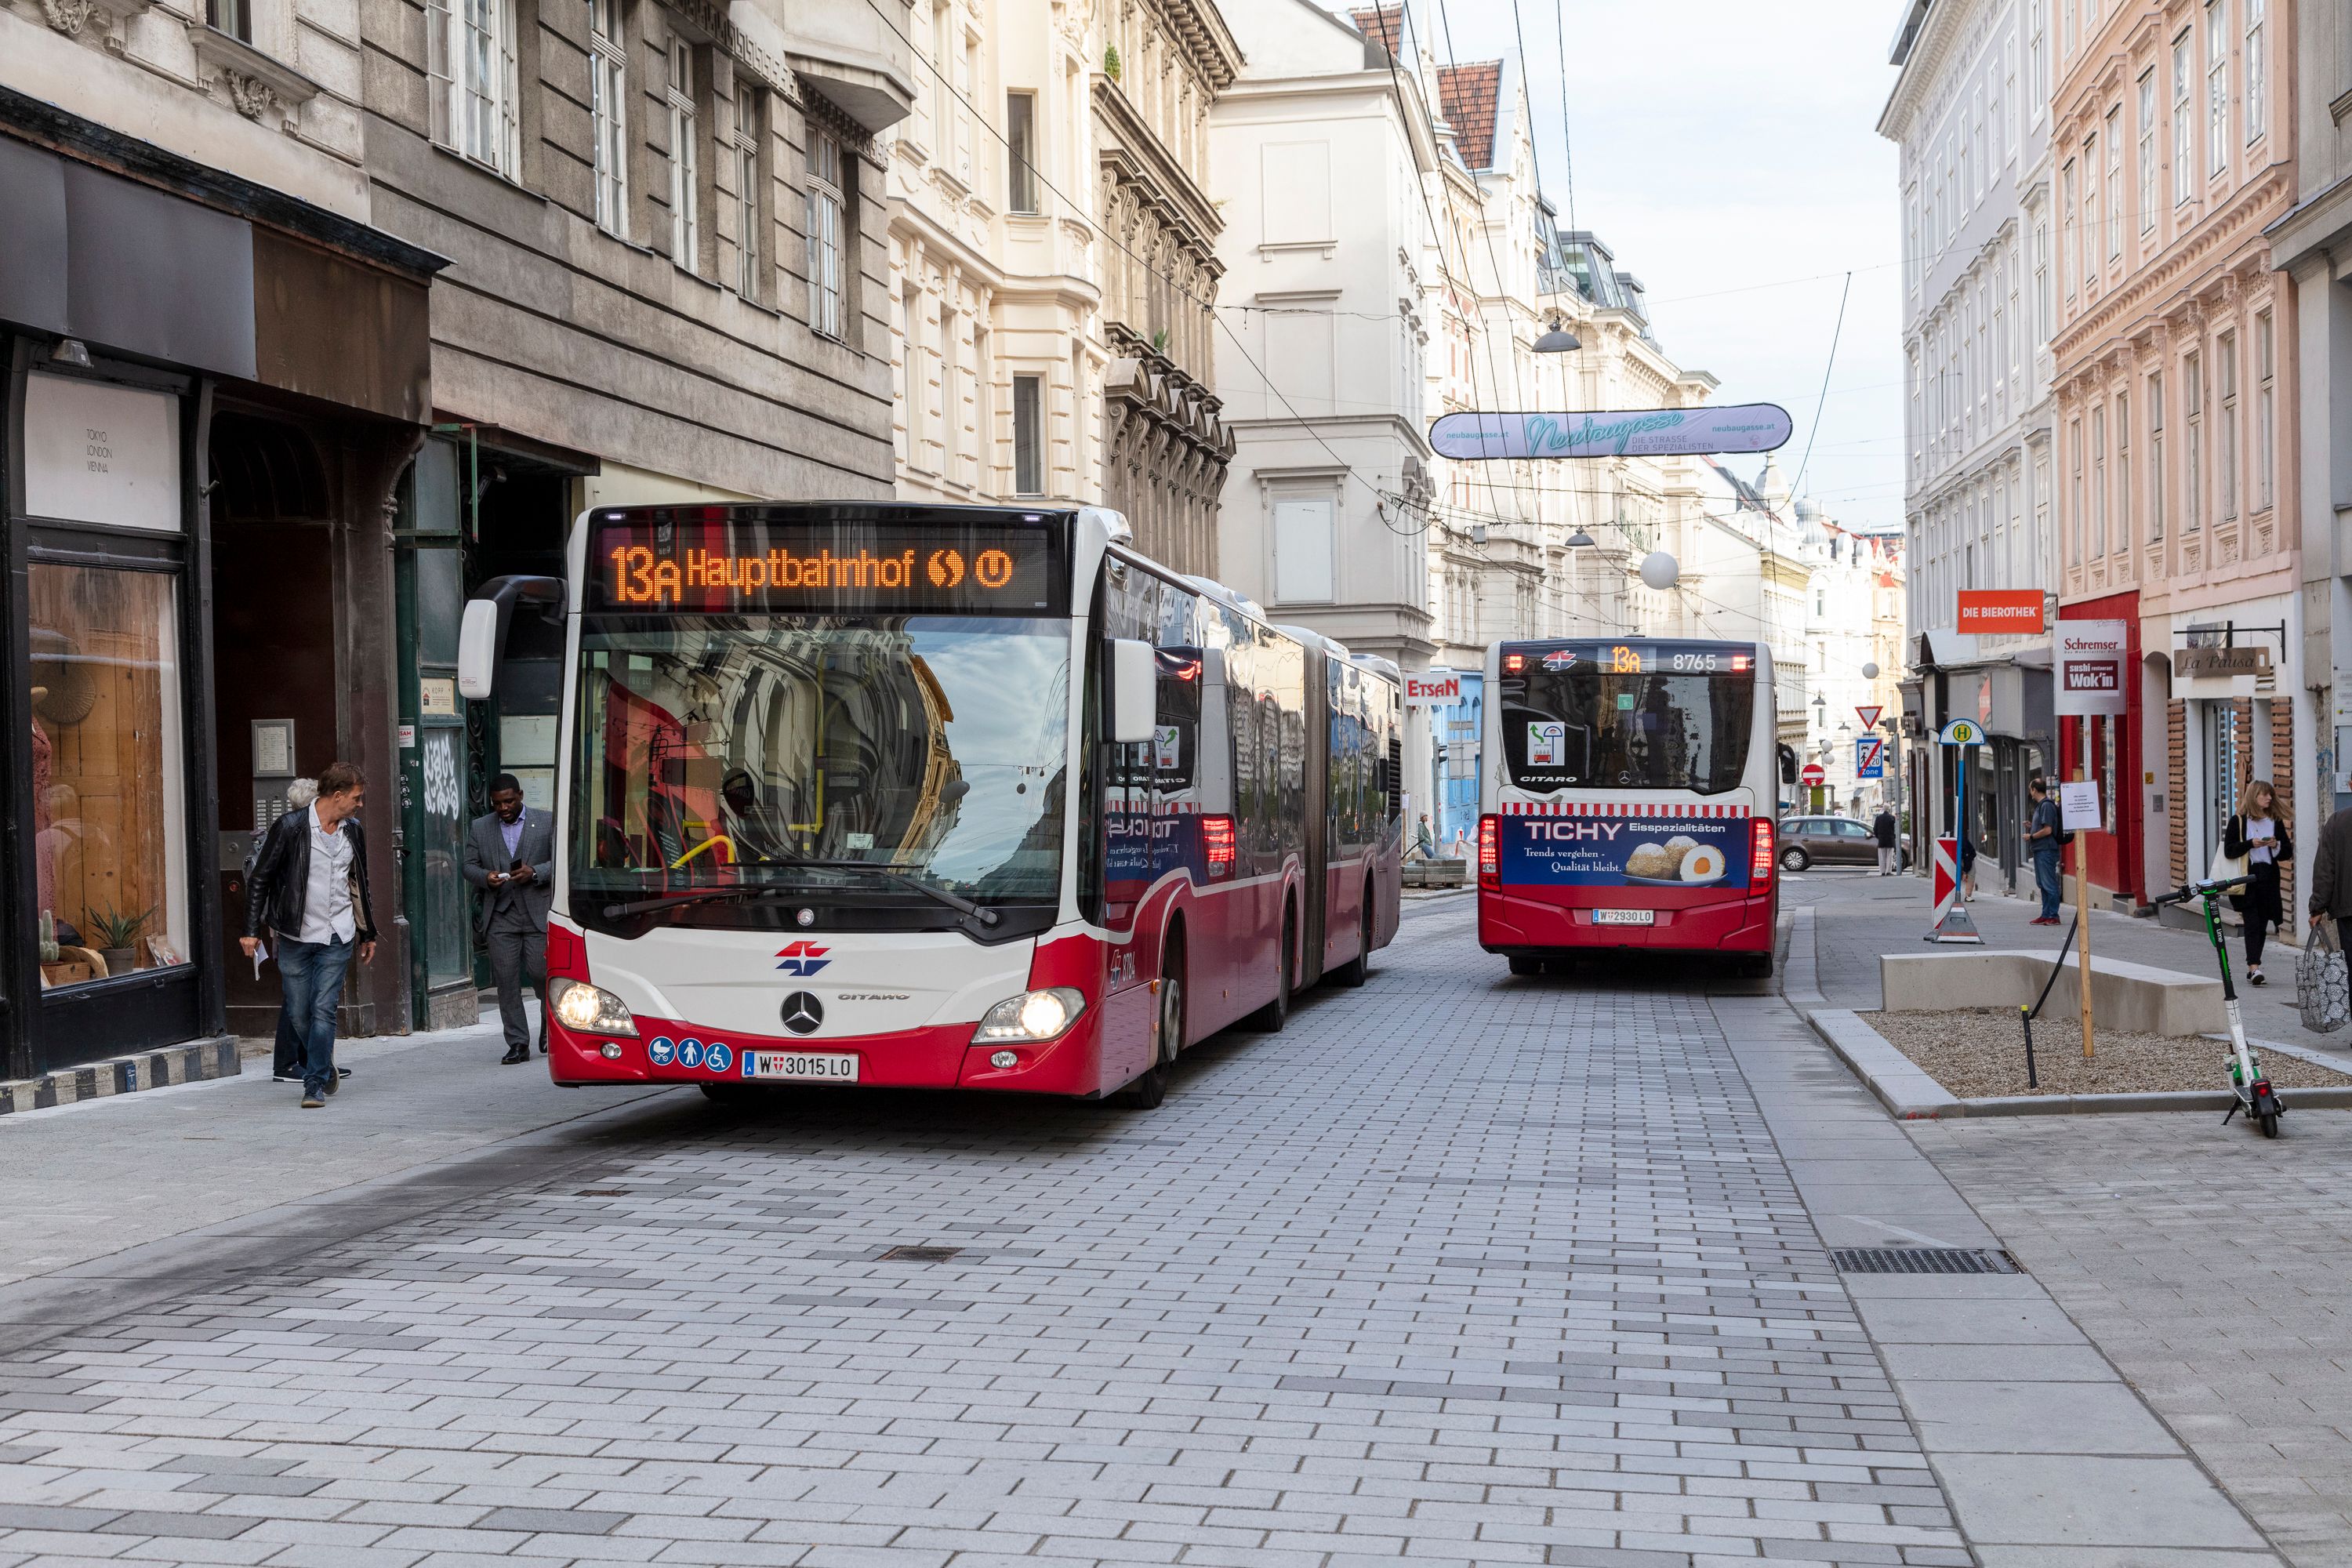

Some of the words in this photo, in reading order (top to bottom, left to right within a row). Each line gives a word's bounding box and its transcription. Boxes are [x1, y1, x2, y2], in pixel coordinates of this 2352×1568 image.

[1526, 411, 1685, 456] Neubaugasse
[1711, 423, 1776, 434] neubaugasse.at
[86, 428, 107, 443] TOKYO
[1446, 430, 1510, 441] neubaugasse.at
[86, 445, 112, 459] LONDON
[1632, 444, 1649, 452] DER
[1652, 442, 1714, 452] SPEZIALISTEN
[612, 546, 681, 601] 13A
[687, 549, 915, 595] Hauptbahnhof
[1962, 607, 1979, 618] DIE
[1981, 606, 2036, 618] BIEROTHEK
[2064, 637, 2118, 650] Schremser
[1612, 646, 1641, 673] 13A
[1673, 654, 1716, 670] 8765
[2181, 656, 2200, 670] La
[2206, 655, 2254, 669] Pausa
[2069, 663, 2091, 672] sushi
[2069, 672, 2114, 688] Wok'in
[1958, 728, 1967, 739] H
[1524, 822, 1623, 841] TICHY
[1629, 822, 1726, 833] Eisspezialitäten
[1524, 847, 1555, 857] Trends
[1557, 848, 1599, 860] vergehen
[1551, 861, 1590, 873] Qualität
[1592, 861, 1622, 872] bleibt.
[1600, 911, 1607, 920] W
[1614, 911, 1638, 920] 2930
[1122, 951, 1135, 982] 8784
[760, 1056, 771, 1073] W
[786, 1057, 826, 1076] 3015
[830, 1059, 851, 1076] LO
